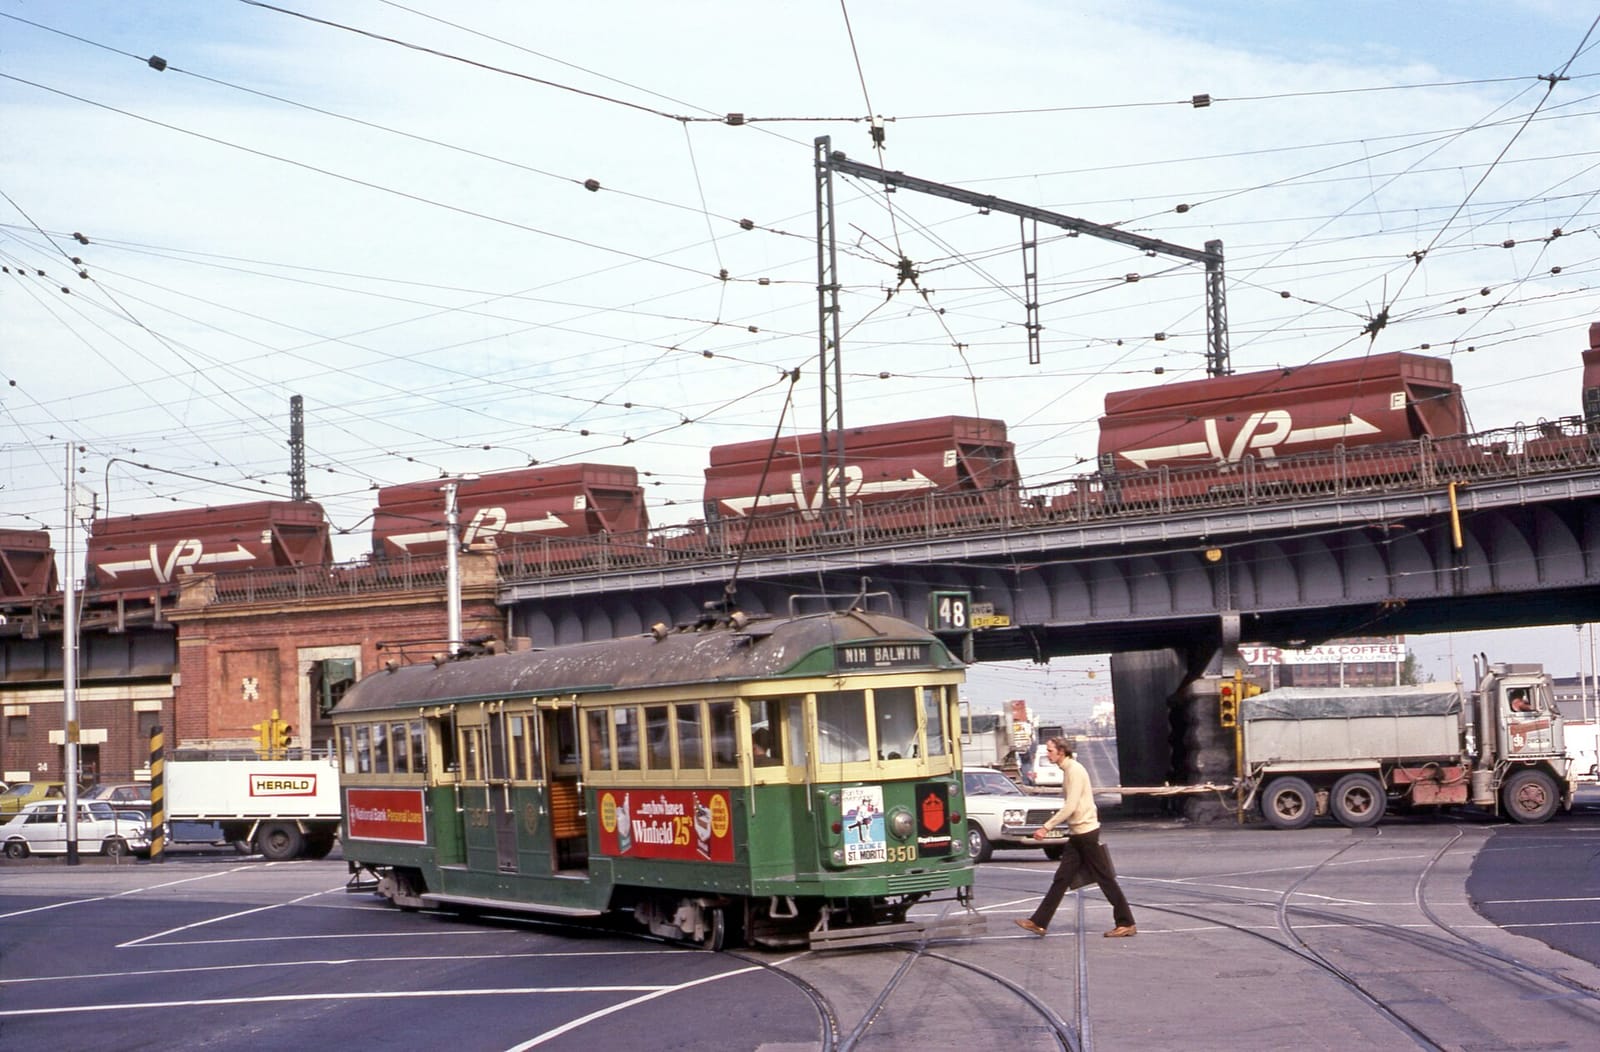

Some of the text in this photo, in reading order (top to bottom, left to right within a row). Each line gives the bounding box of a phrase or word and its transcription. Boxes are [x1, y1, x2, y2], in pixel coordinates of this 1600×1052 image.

[939, 598, 965, 627] 48
[874, 646, 921, 661] BALWYN
[1296, 647, 1324, 656] TEA
[1338, 645, 1399, 655] COFFEE
[256, 780, 309, 790] HERALD
[632, 820, 673, 843] Winfield
[860, 849, 885, 860] MORITZ
[887, 845, 916, 863] 350
